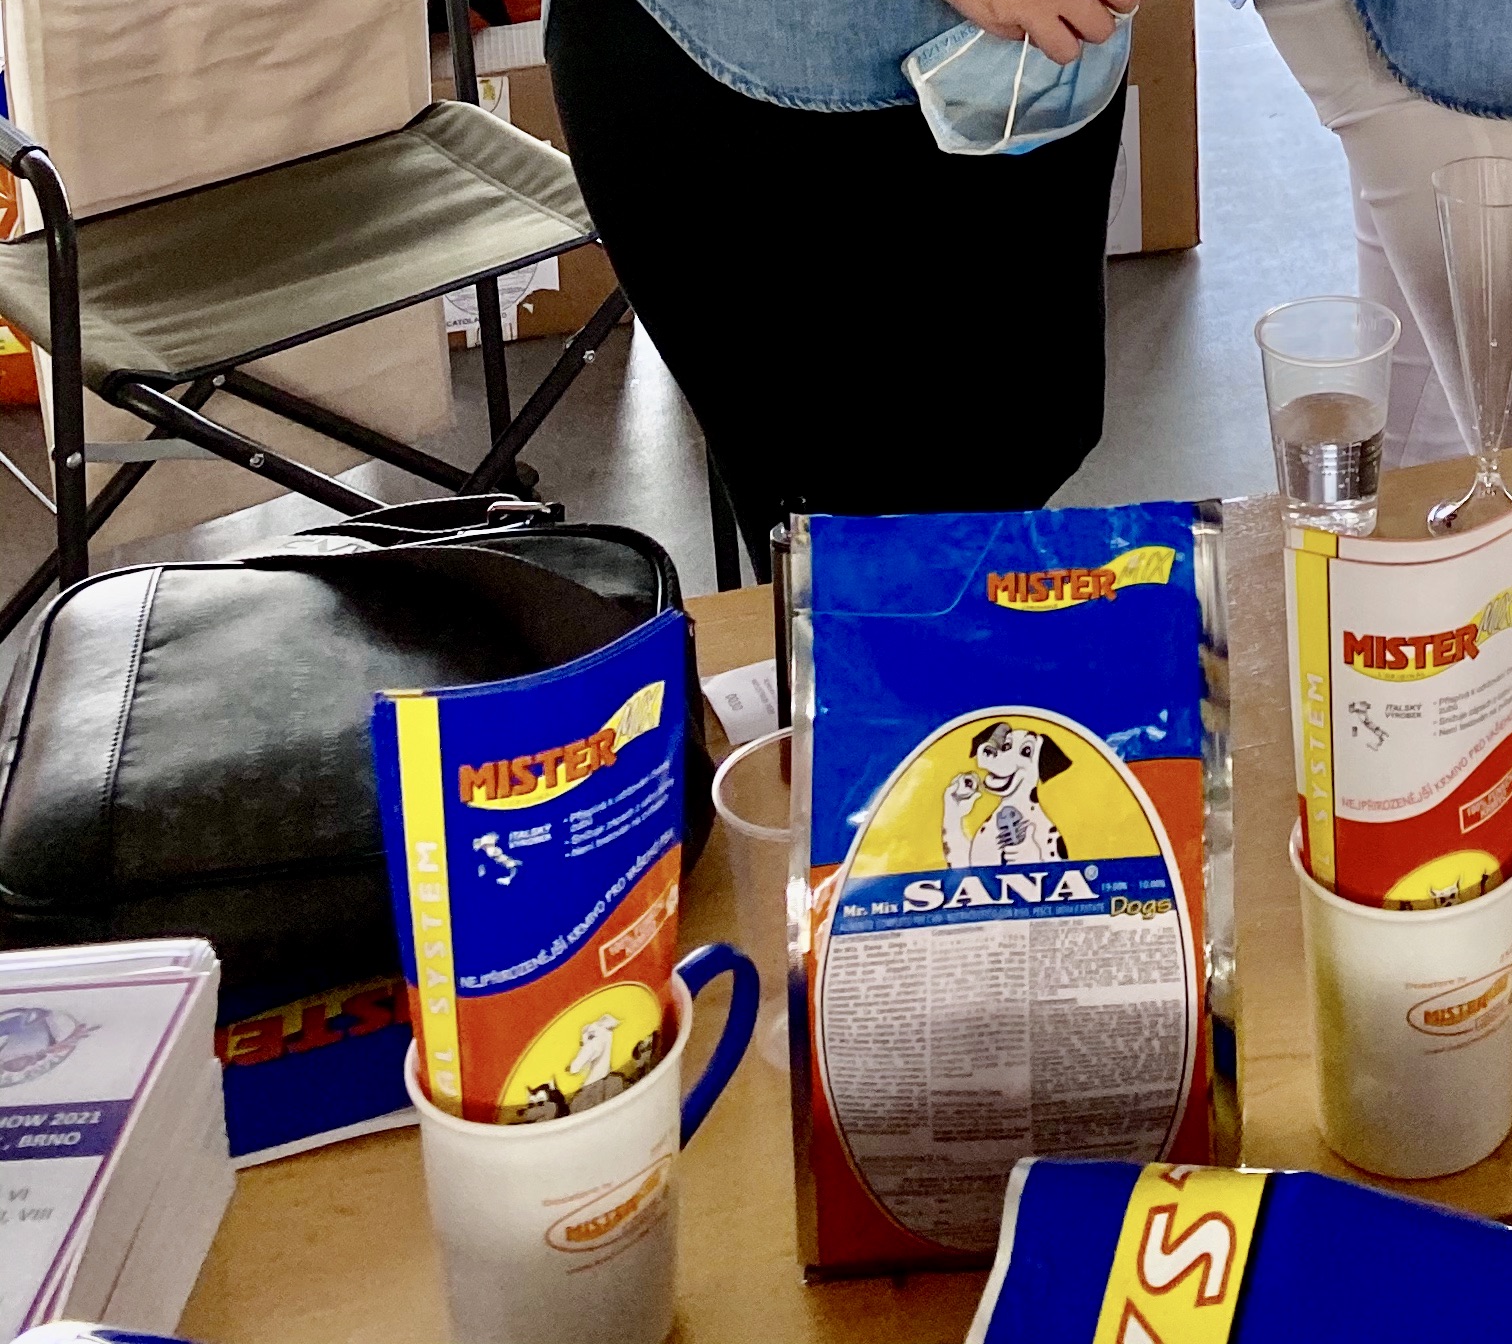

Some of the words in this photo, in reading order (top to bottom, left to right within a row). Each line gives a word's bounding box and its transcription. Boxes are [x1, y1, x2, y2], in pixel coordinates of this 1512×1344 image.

[988, 568, 1118, 604] MISTER
[1343, 624, 1480, 670] MISTER
[459, 728, 617, 803] MISTER
[1307, 671, 1326, 820] SYSTEM
[843, 904, 868, 918] Mr.
[871, 901, 899, 915] Mix
[903, 869, 1100, 913] SANA
[1110, 895, 1173, 921] Dogs
[416, 840, 452, 1015] SYSTEM
[18, 1131, 82, 1149] BRNO
[50, 1110, 102, 1127] 2021
